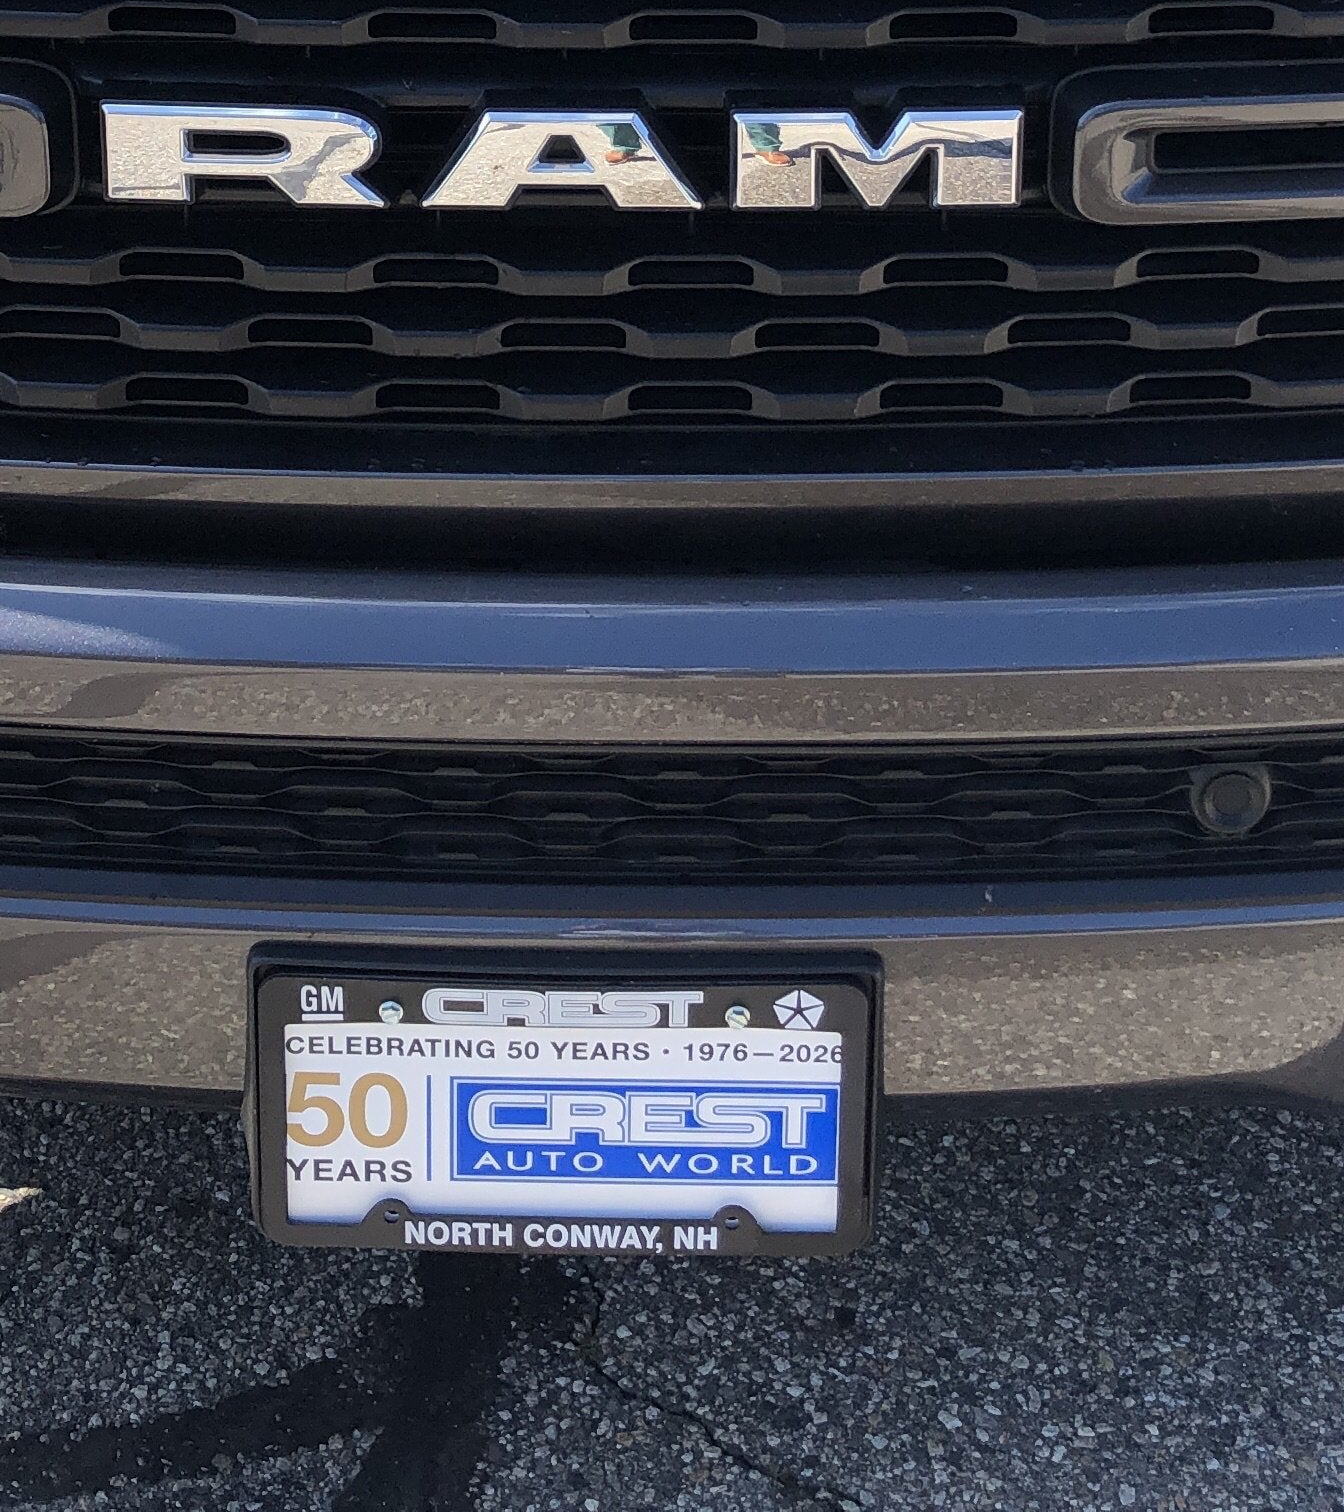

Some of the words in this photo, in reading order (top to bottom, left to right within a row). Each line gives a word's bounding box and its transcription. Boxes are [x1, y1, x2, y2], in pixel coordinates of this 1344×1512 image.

[101, 100, 1025, 209] RAM
[301, 985, 344, 1012] GM
[422, 988, 704, 1028] CREST
[285, 1036, 495, 1059] CELEBRATING
[507, 1041, 540, 1060] 50
[551, 1042, 650, 1061] YEARS
[287, 1071, 408, 1148] 50
[468, 1089, 826, 1149] CREST
[286, 1158, 413, 1183] YEARS
[473, 1150, 605, 1172] AUTO
[637, 1153, 818, 1175] WORLD
[404, 1221, 513, 1247] NORTH
[523, 1223, 663, 1254] CONWAY,
[673, 1226, 719, 1250] NH
